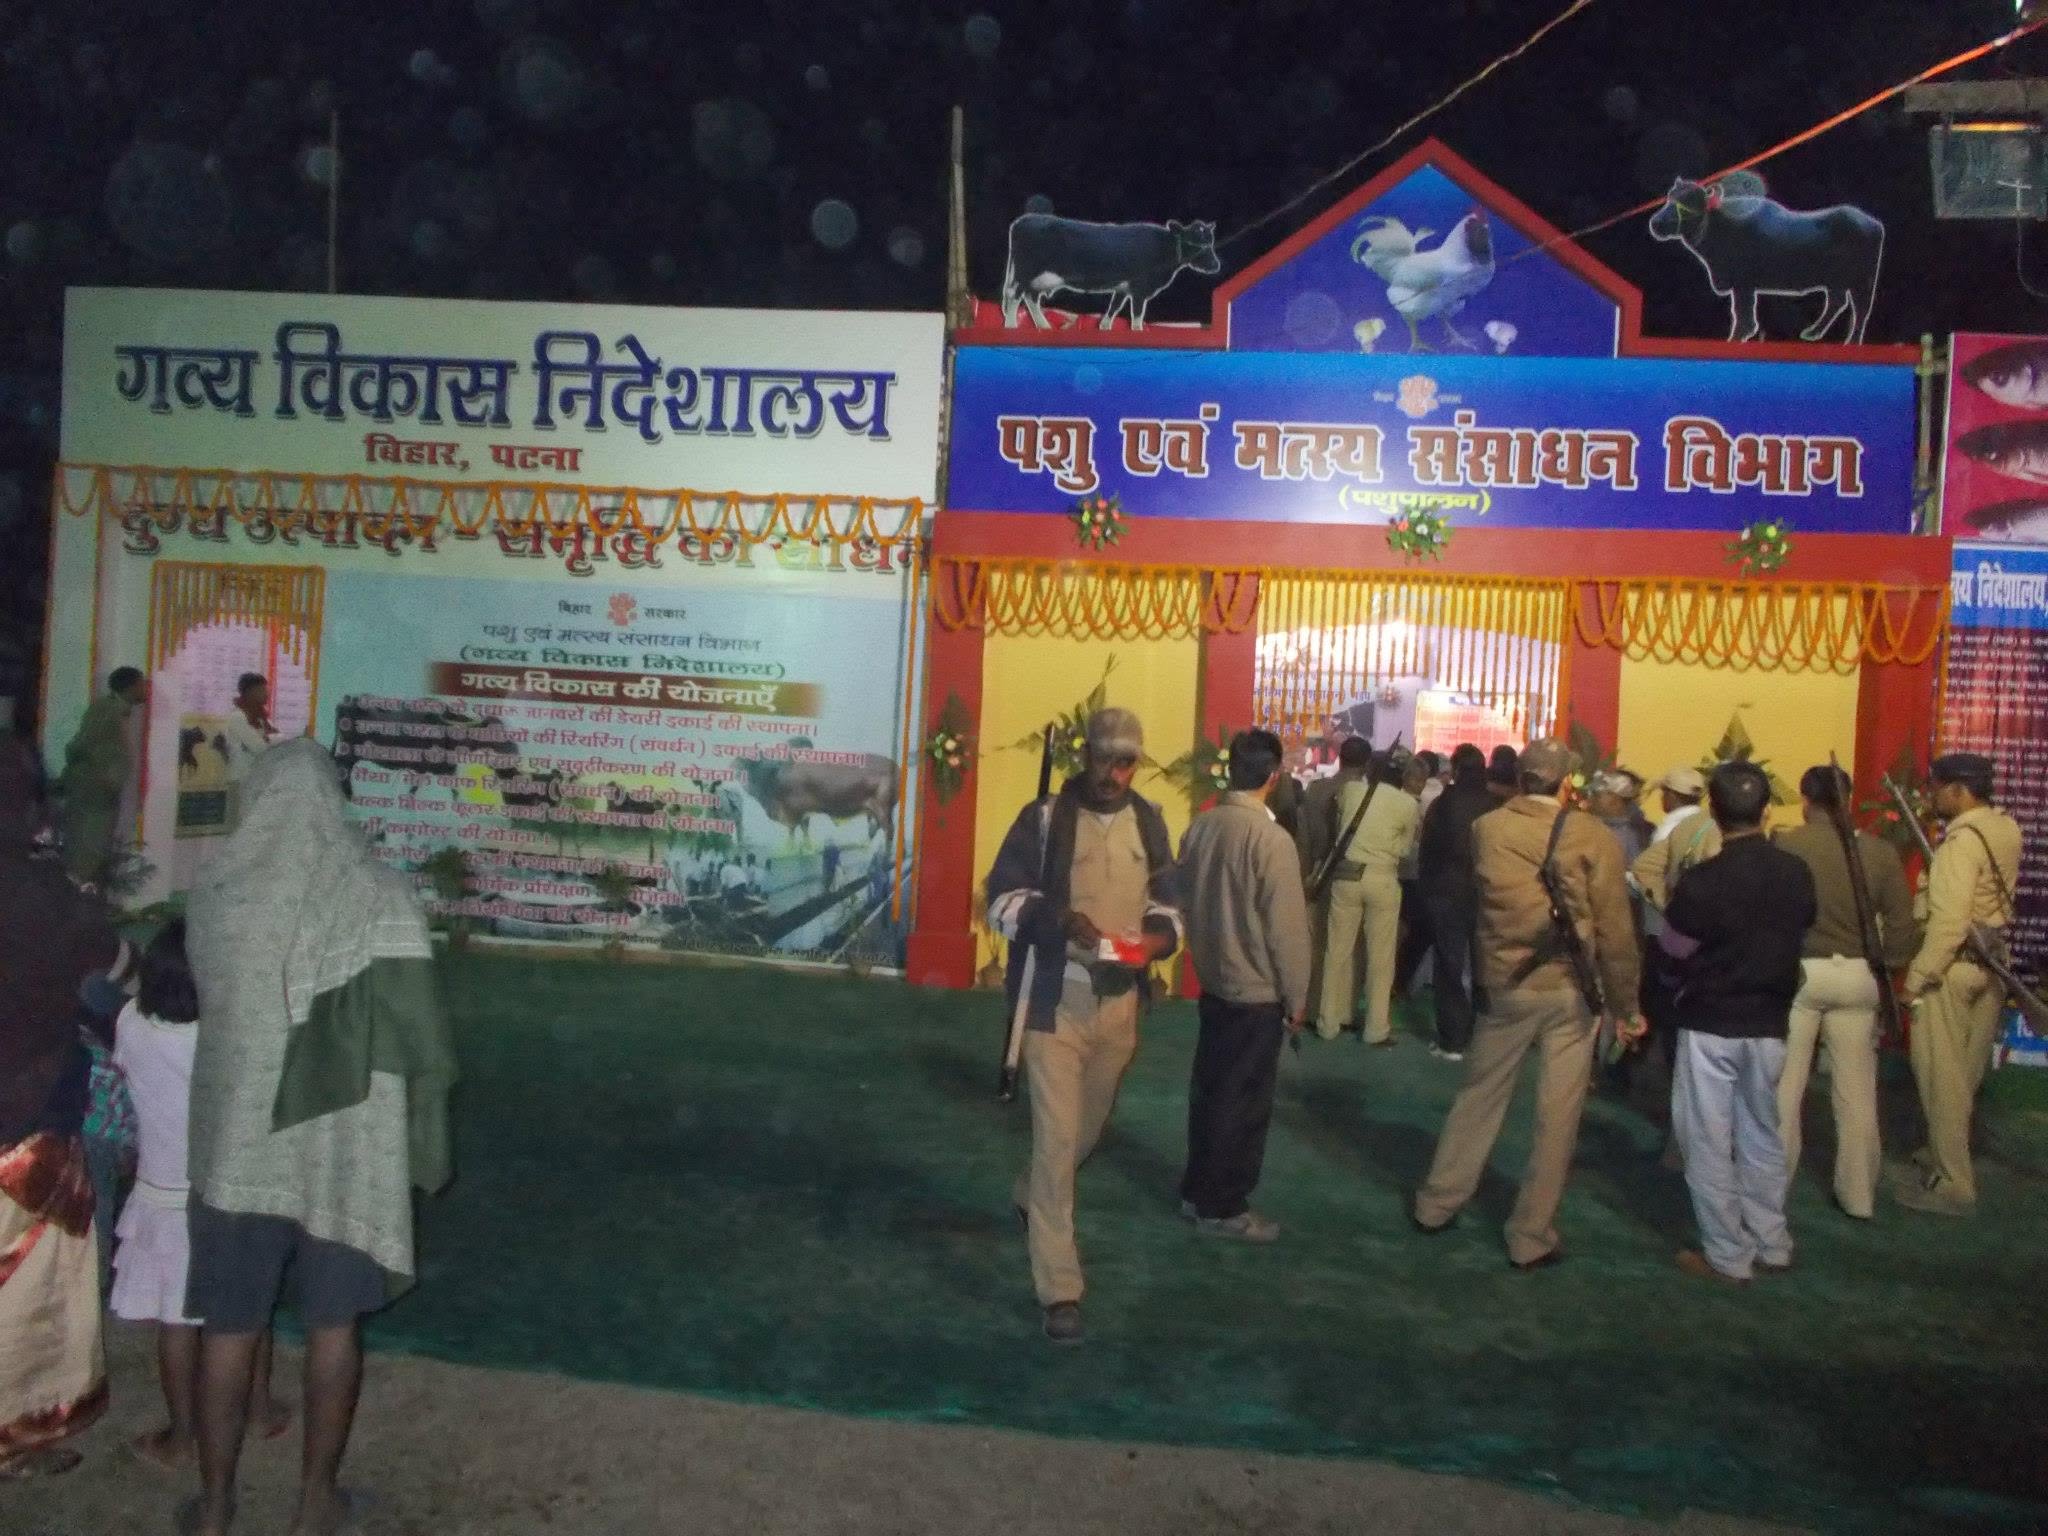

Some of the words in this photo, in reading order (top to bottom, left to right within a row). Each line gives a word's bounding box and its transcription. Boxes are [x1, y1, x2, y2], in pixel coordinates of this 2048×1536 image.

[115, 343, 258, 416] गव्य
[274, 321, 518, 429] विकास
[532, 329, 898, 446] निदेशालय
[363, 431, 471, 472] बिहार,
[490, 445, 584, 474] पटना
[997, 415, 1098, 495] पशु
[1119, 403, 1220, 479] एवं
[1232, 420, 1386, 484] मत्स्य
[1408, 410, 1639, 491] संसाधन
[1665, 416, 1867, 499] विभाग
[558, 599, 592, 616] बिहार
[644, 607, 688, 621] सरकार
[460, 672, 517, 693] गव्य
[523, 669, 614, 698] विकास
[622, 677, 663, 702] की
